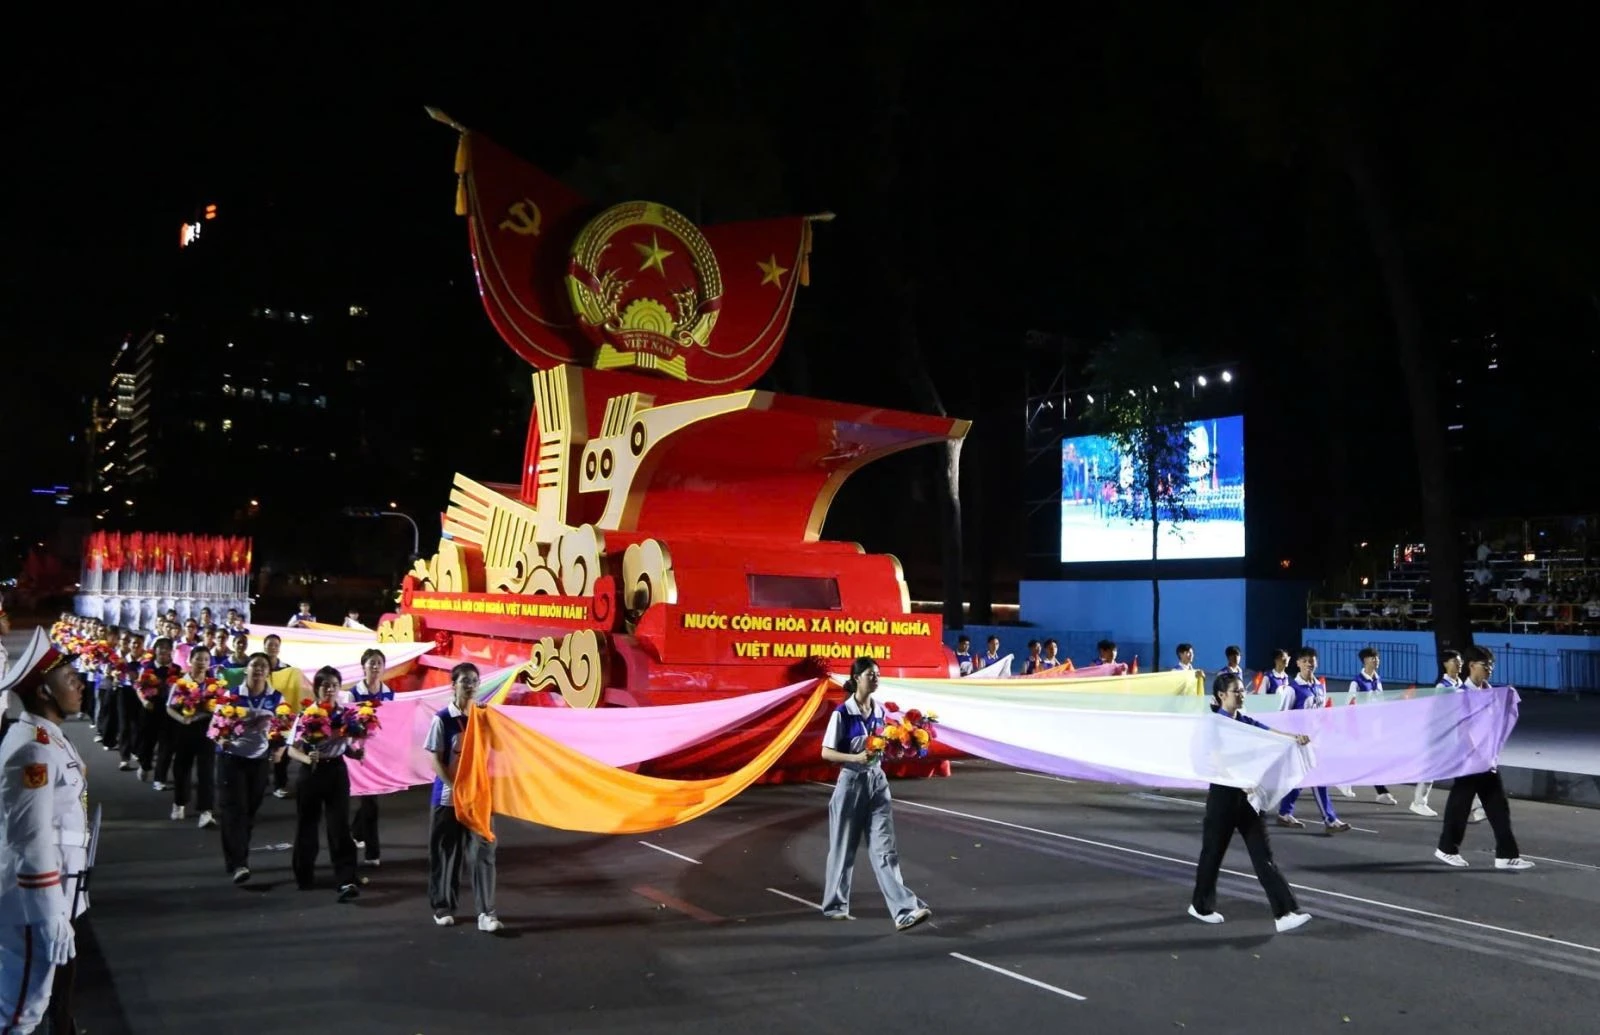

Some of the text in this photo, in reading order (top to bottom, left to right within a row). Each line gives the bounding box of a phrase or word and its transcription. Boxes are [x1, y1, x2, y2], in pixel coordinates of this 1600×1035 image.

[506, 602, 521, 617] VIỆT
[521, 603, 538, 617] NAM
[539, 602, 562, 618] MUÔN
[684, 610, 931, 636] NƯỚC CỘNG HÒA XÃ HỘI CHỦ NGHĨA
[735, 640, 771, 660] VIỆT
[773, 643, 808, 658] NAM
[810, 641, 852, 658] MUÔN
